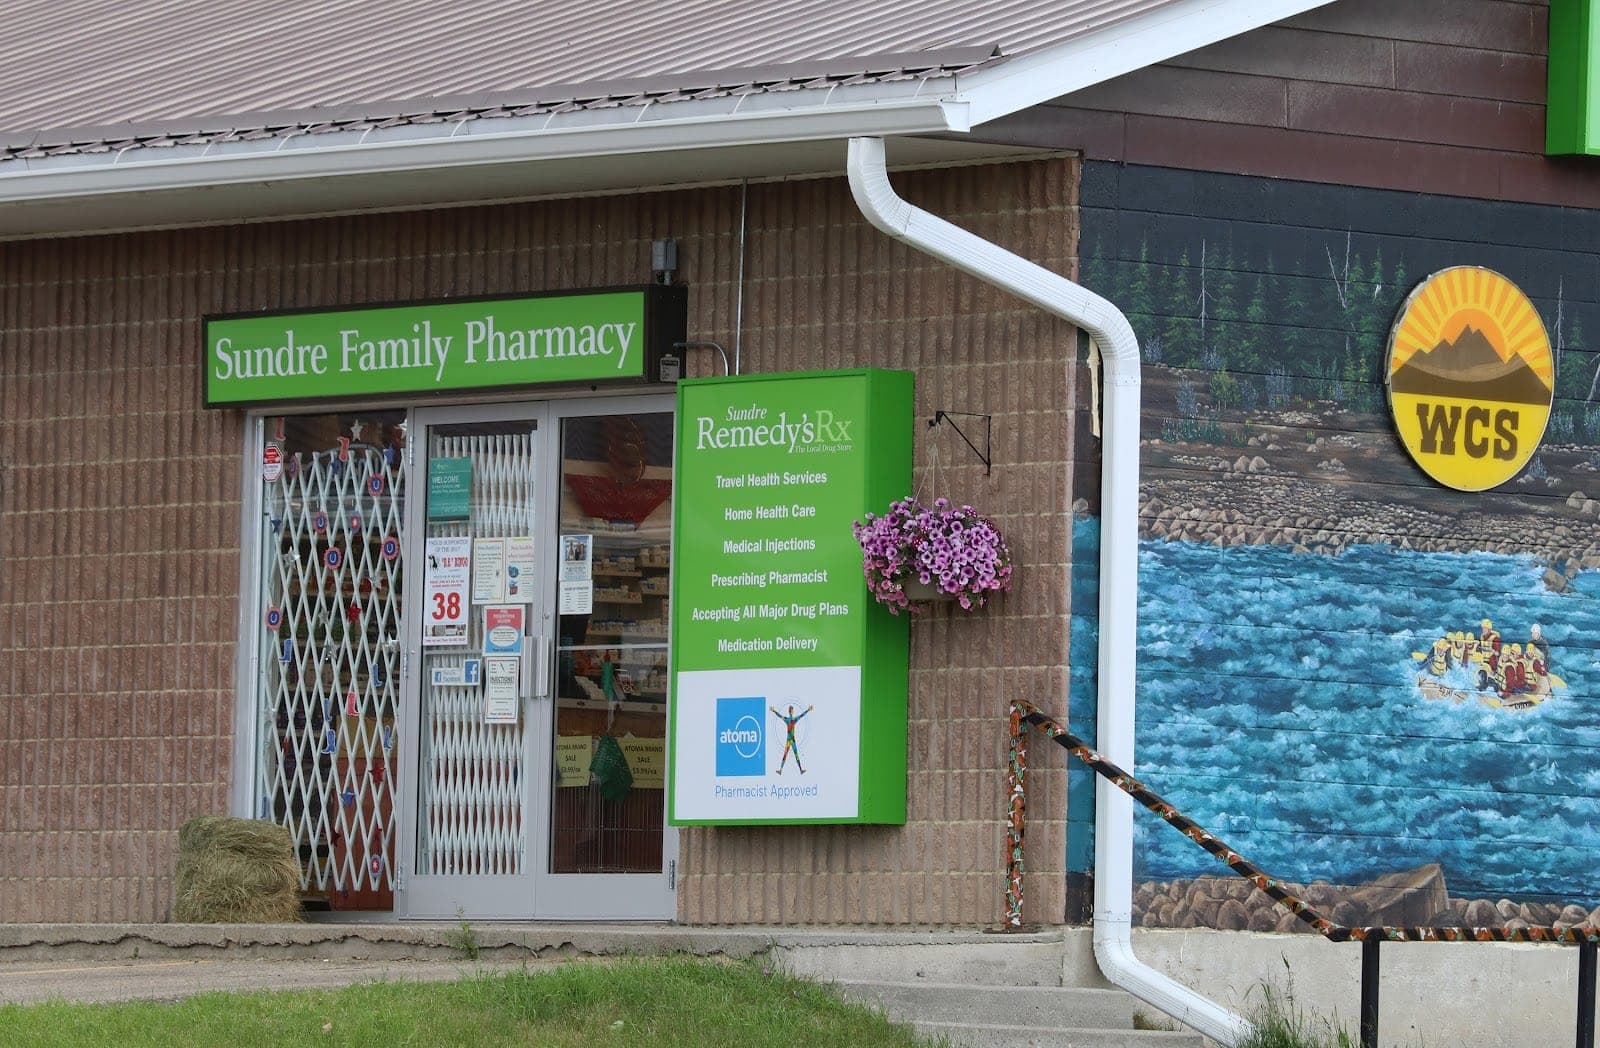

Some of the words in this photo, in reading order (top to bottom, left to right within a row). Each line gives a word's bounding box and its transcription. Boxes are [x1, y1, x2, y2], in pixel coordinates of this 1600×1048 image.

[215, 329, 328, 380] Sundre
[339, 320, 453, 382] Family
[464, 315, 636, 369] Pharmacy
[725, 403, 767, 422] Sundre
[1416, 403, 1519, 461] WCS
[716, 474, 744, 488] Travel
[747, 472, 780, 487] Health
[783, 471, 828, 485] Services
[725, 507, 752, 520] Home
[756, 505, 788, 519] Health
[791, 504, 816, 518] Care
[723, 539, 762, 553] Medical
[765, 538, 816, 554] Injections
[711, 572, 766, 588] Prescribing
[769, 569, 828, 585] Pharmacist
[432, 592, 461, 620] 38
[691, 606, 740, 622] Accepting
[743, 605, 756, 618] All
[759, 604, 788, 620] Major
[791, 603, 816, 619] Drug
[819, 602, 849, 616] Plans
[718, 637, 772, 652] Medication
[776, 636, 818, 652] Delivery
[720, 729, 757, 743] atoma
[715, 785, 767, 798] Pharmacist
[770, 784, 818, 799] Approved
